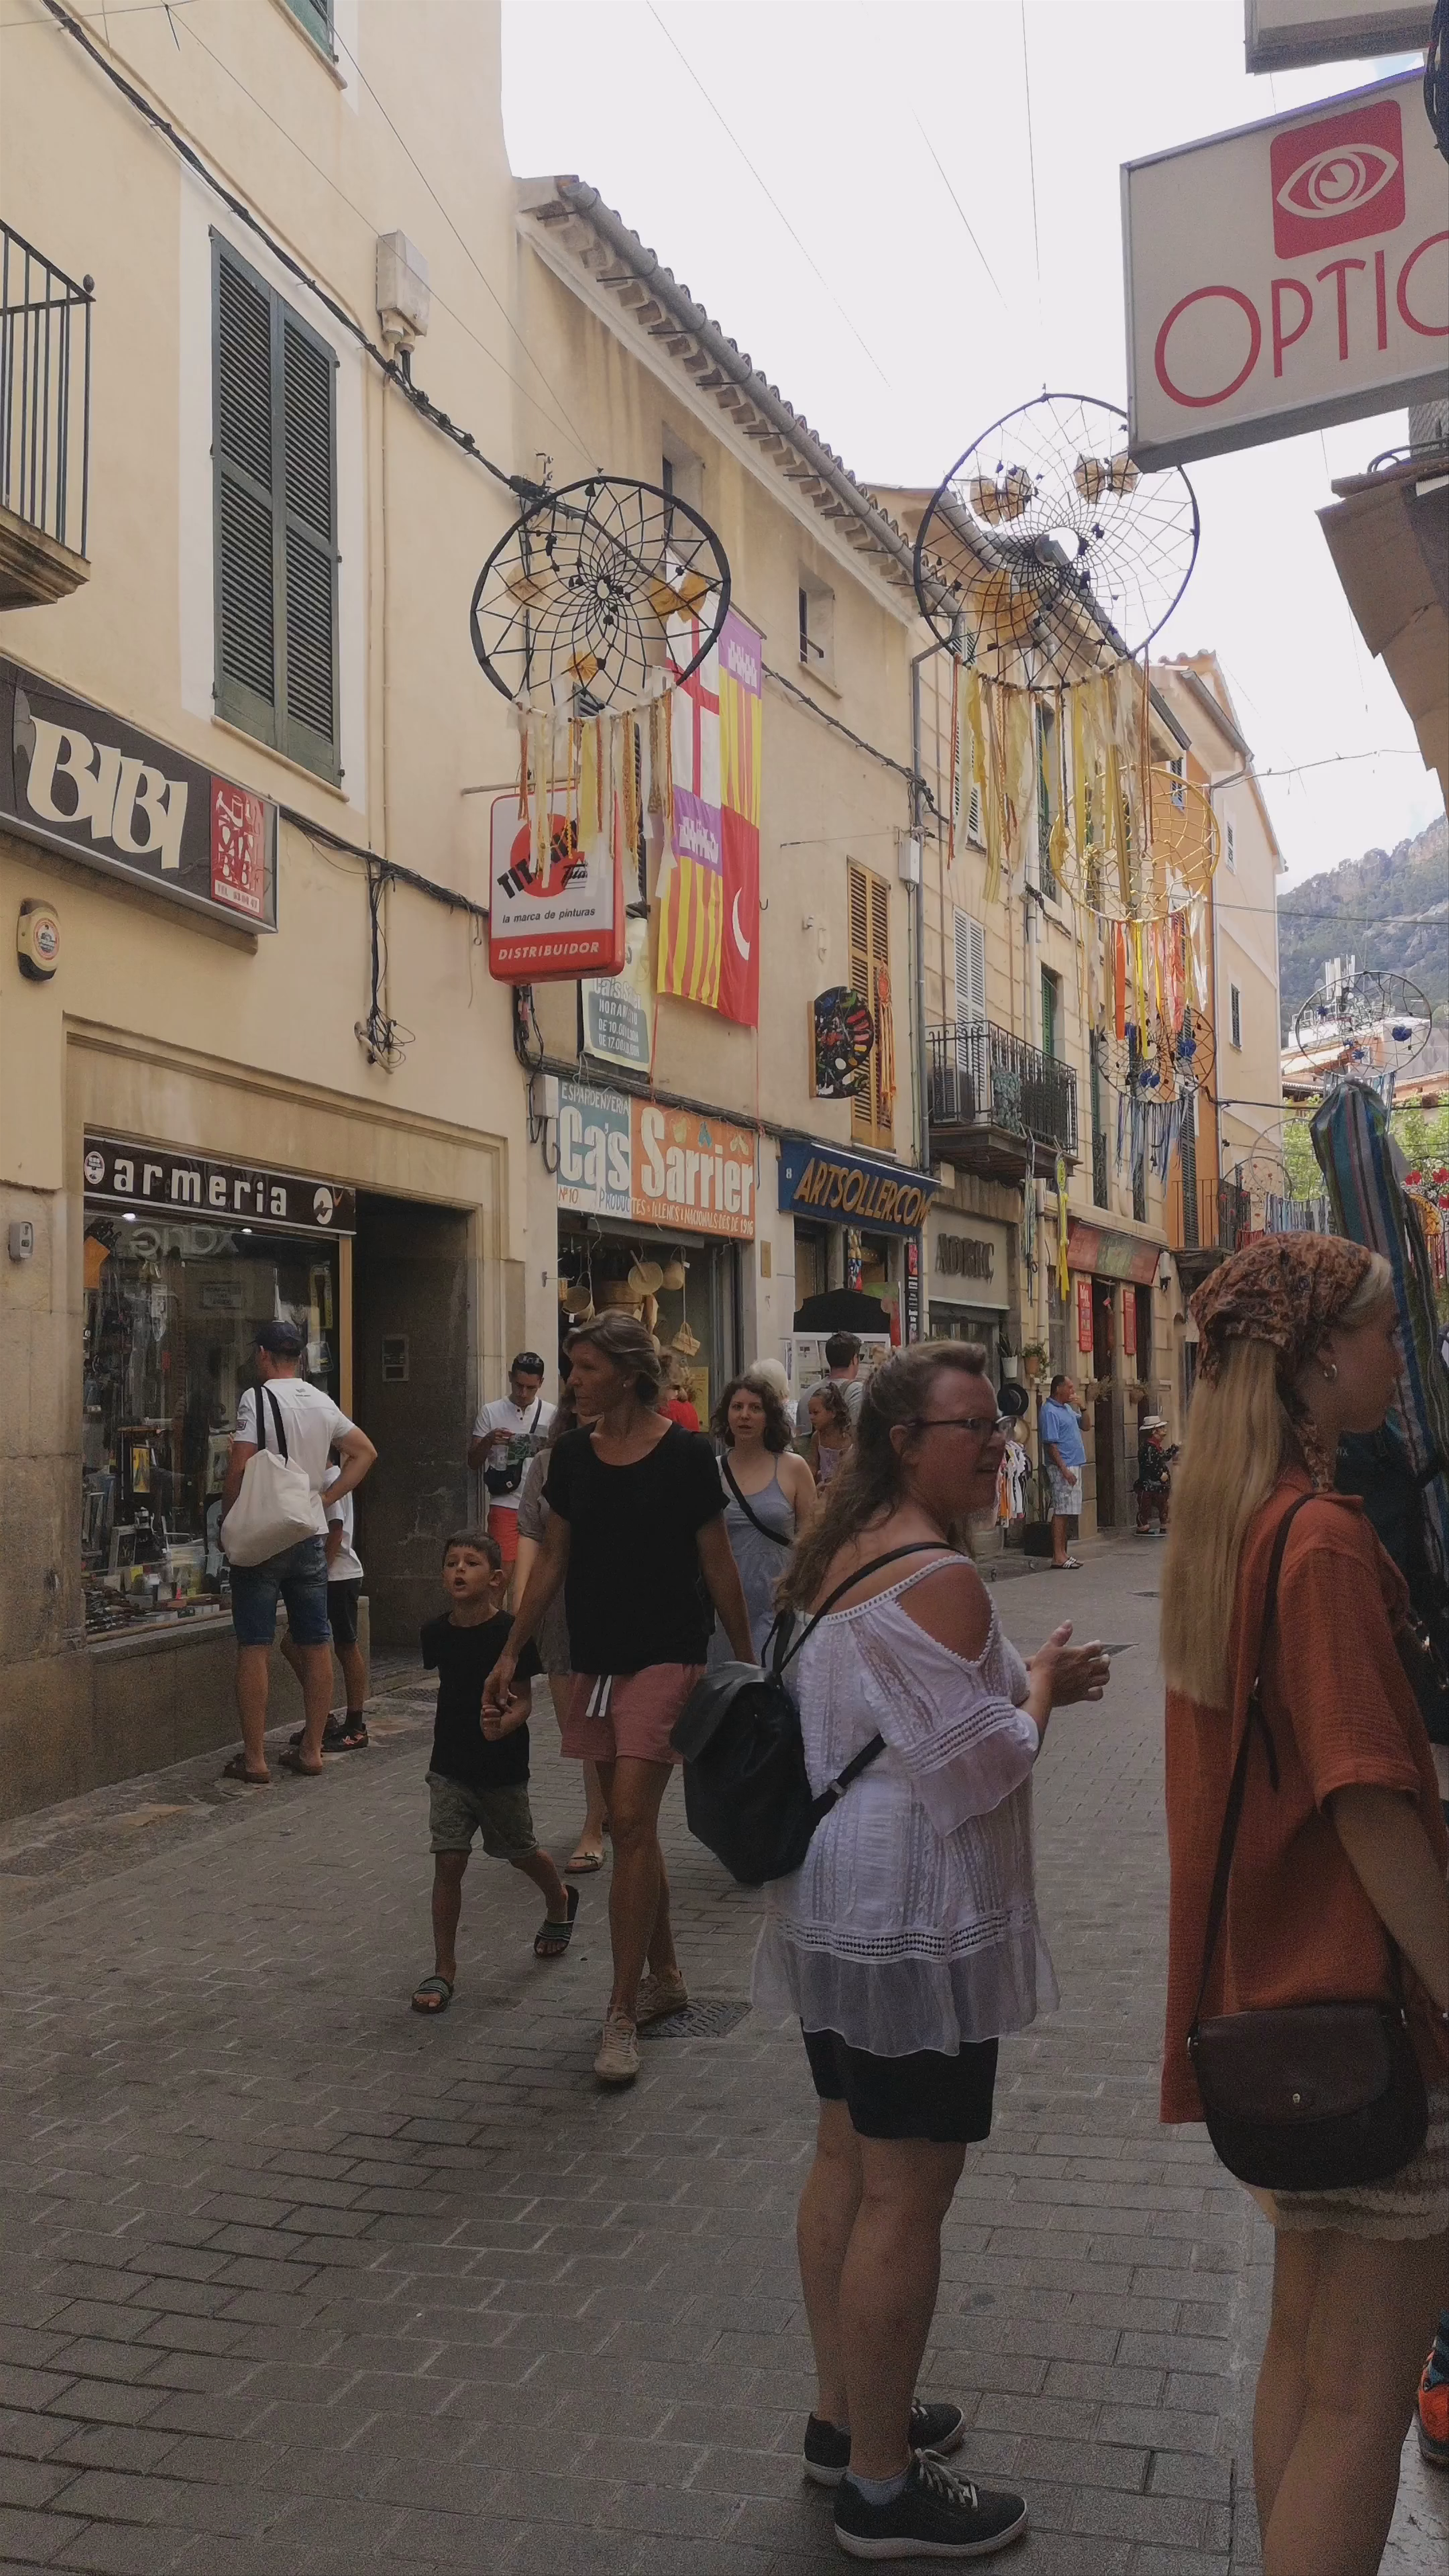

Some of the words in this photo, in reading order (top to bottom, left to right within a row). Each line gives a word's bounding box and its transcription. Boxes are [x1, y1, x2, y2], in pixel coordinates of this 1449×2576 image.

[26, 715, 188, 869] BIBI
[502, 915, 510, 923] la
[514, 913, 540, 922] marca
[544, 910, 555, 920] de
[558, 908, 595, 920] pinturas
[498, 942, 599, 960] DISTRIBUIDOR
[561, 1083, 629, 1116] ESPARDENYERIA
[560, 1106, 629, 1191] Ca's
[641, 1107, 753, 1216] Sarrier
[786, 1167, 792, 1179] 8
[113, 1158, 286, 1216] armeria
[569, 1188, 578, 1204] 10
